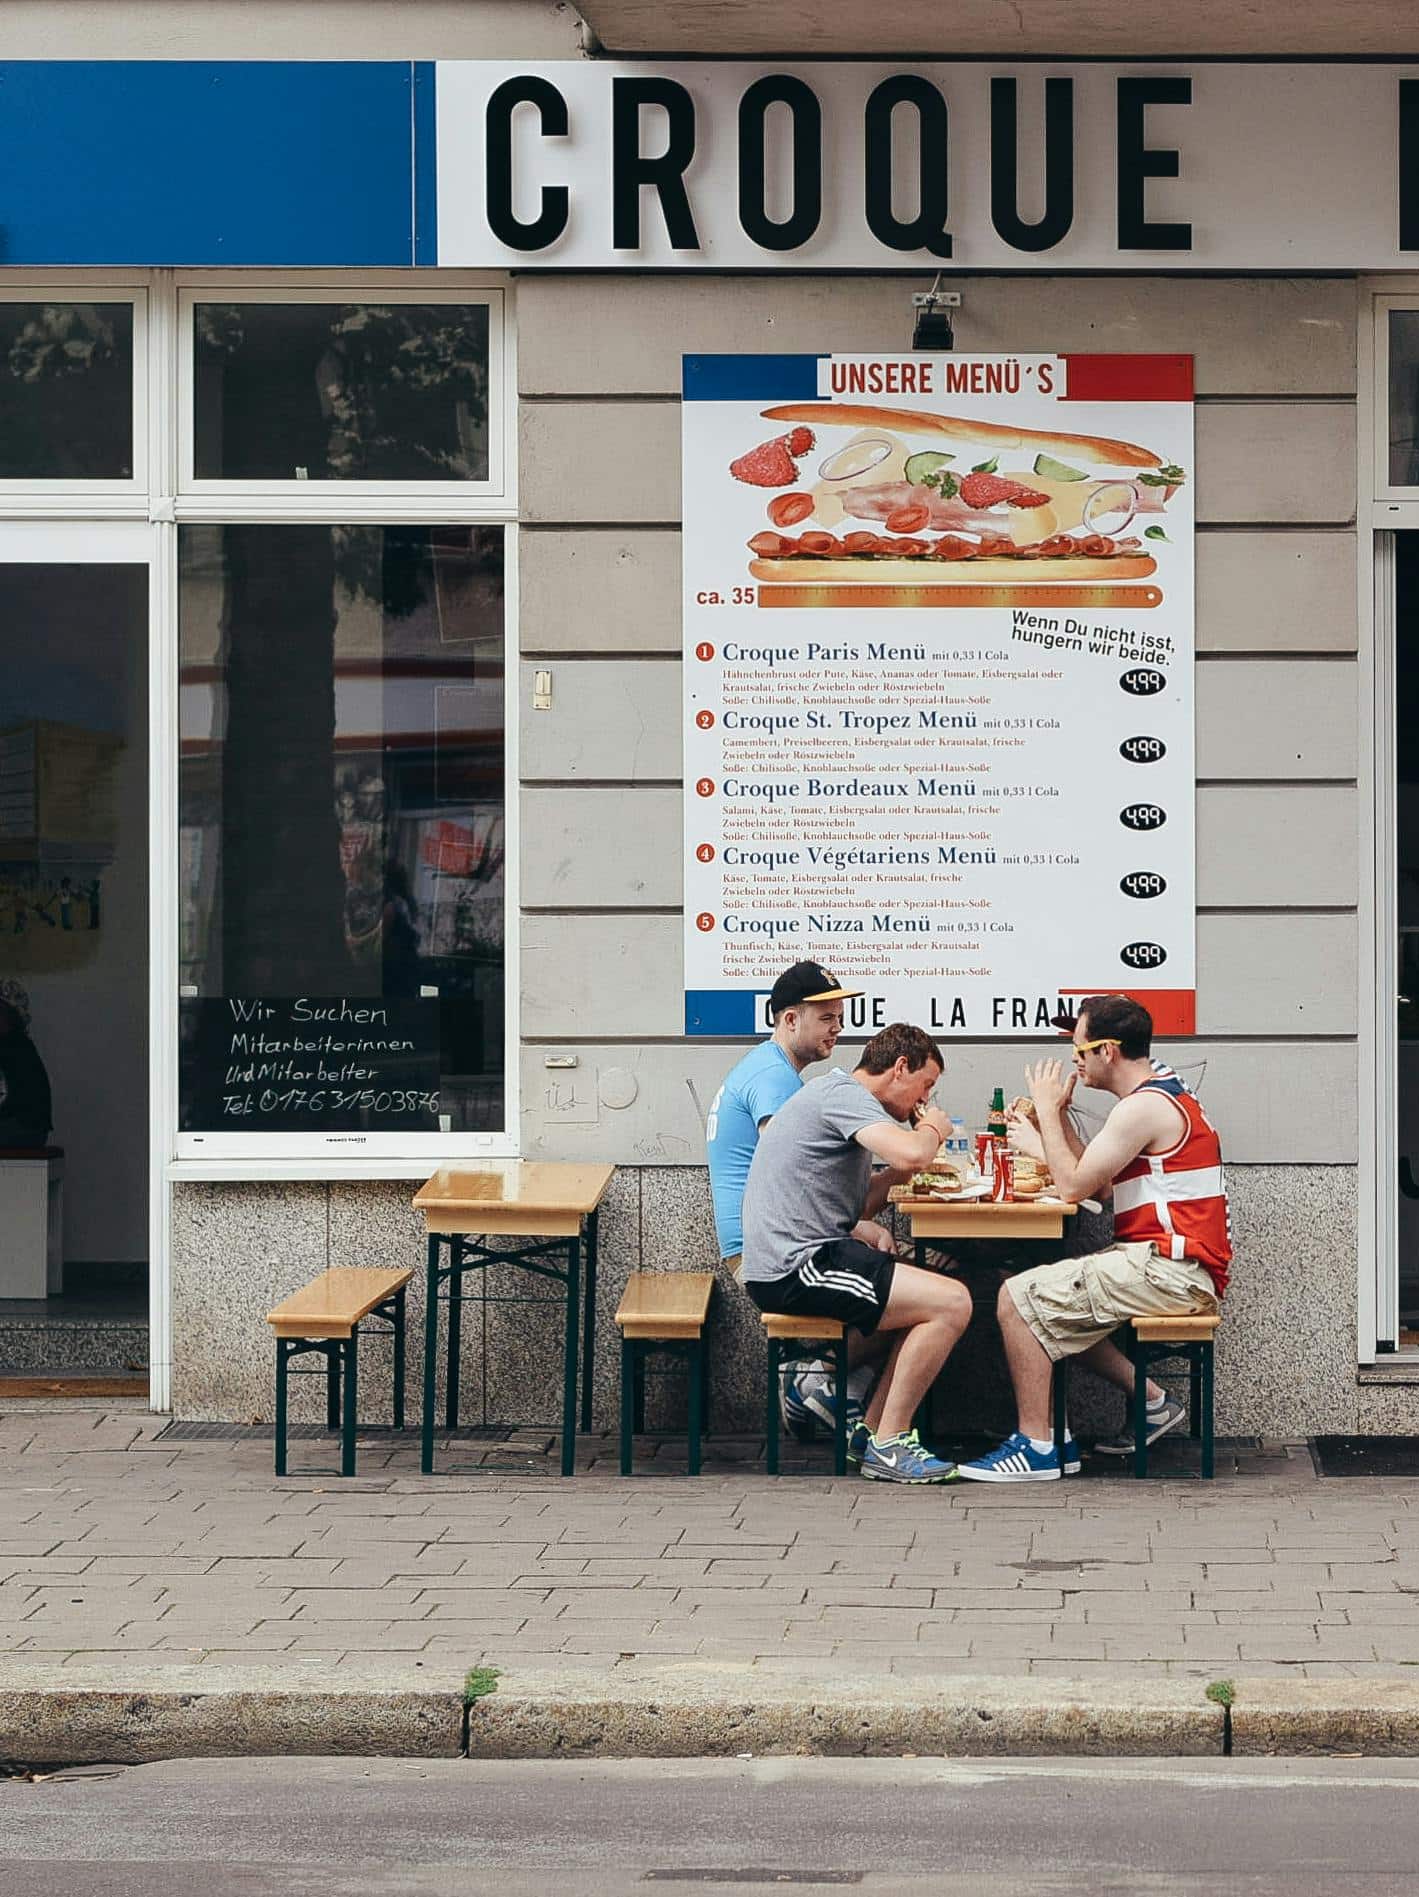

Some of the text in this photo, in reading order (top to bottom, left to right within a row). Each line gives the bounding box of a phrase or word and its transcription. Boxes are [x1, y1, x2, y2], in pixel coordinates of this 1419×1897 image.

[485, 74, 1193, 259] CROQUE
[831, 363, 933, 394] UNSERE
[697, 587, 754, 604] ca. 35
[1012, 610, 1176, 653] Wenn Du nicht isst,
[723, 643, 799, 667] Croque
[808, 642, 859, 660] Paris
[868, 643, 925, 660] Menü
[932, 651, 949, 660] mit
[953, 651, 974, 661] 0,33
[985, 651, 1008, 660] Cola
[1011, 626, 1171, 666] hungern wir beide.
[723, 711, 799, 735] Croque
[807, 711, 831, 728] St.
[839, 711, 910, 735] Tropez
[918, 711, 977, 728] Menü
[984, 719, 1000, 728] mit
[1004, 719, 1025, 728] 0,33
[1036, 719, 1060, 728] Cola
[854, 737, 911, 748] Eisbergsalat
[914, 737, 935, 746] oder
[993, 736, 1025, 746] frische
[723, 779, 800, 803] Croque
[807, 778, 909, 796] Bordeaux
[917, 779, 975, 796] Menü
[983, 787, 999, 796] mit
[1003, 787, 1024, 797] 0,33
[1035, 787, 1059, 796] Cola
[723, 847, 799, 871] Croque
[806, 846, 929, 871] Végétariens
[938, 847, 996, 864] Menü
[1003, 854, 1020, 864] mit
[1024, 855, 1045, 864] 0,33
[1056, 854, 1079, 864] Cola
[791, 873, 848, 885] Eisbergsalat
[851, 873, 872, 882] oder
[931, 873, 963, 882] frische
[723, 915, 800, 939] Croque
[808, 914, 864, 932] Nizza
[872, 915, 930, 932] Menü
[937, 923, 954, 932] mit
[958, 923, 979, 932] 0,33
[990, 923, 1013, 932] Cola
[230, 998, 388, 1026] Wir Suchen
[930, 998, 1075, 1028] LA FRAN
[230, 1033, 415, 1055] Mitarbeiterinnen
